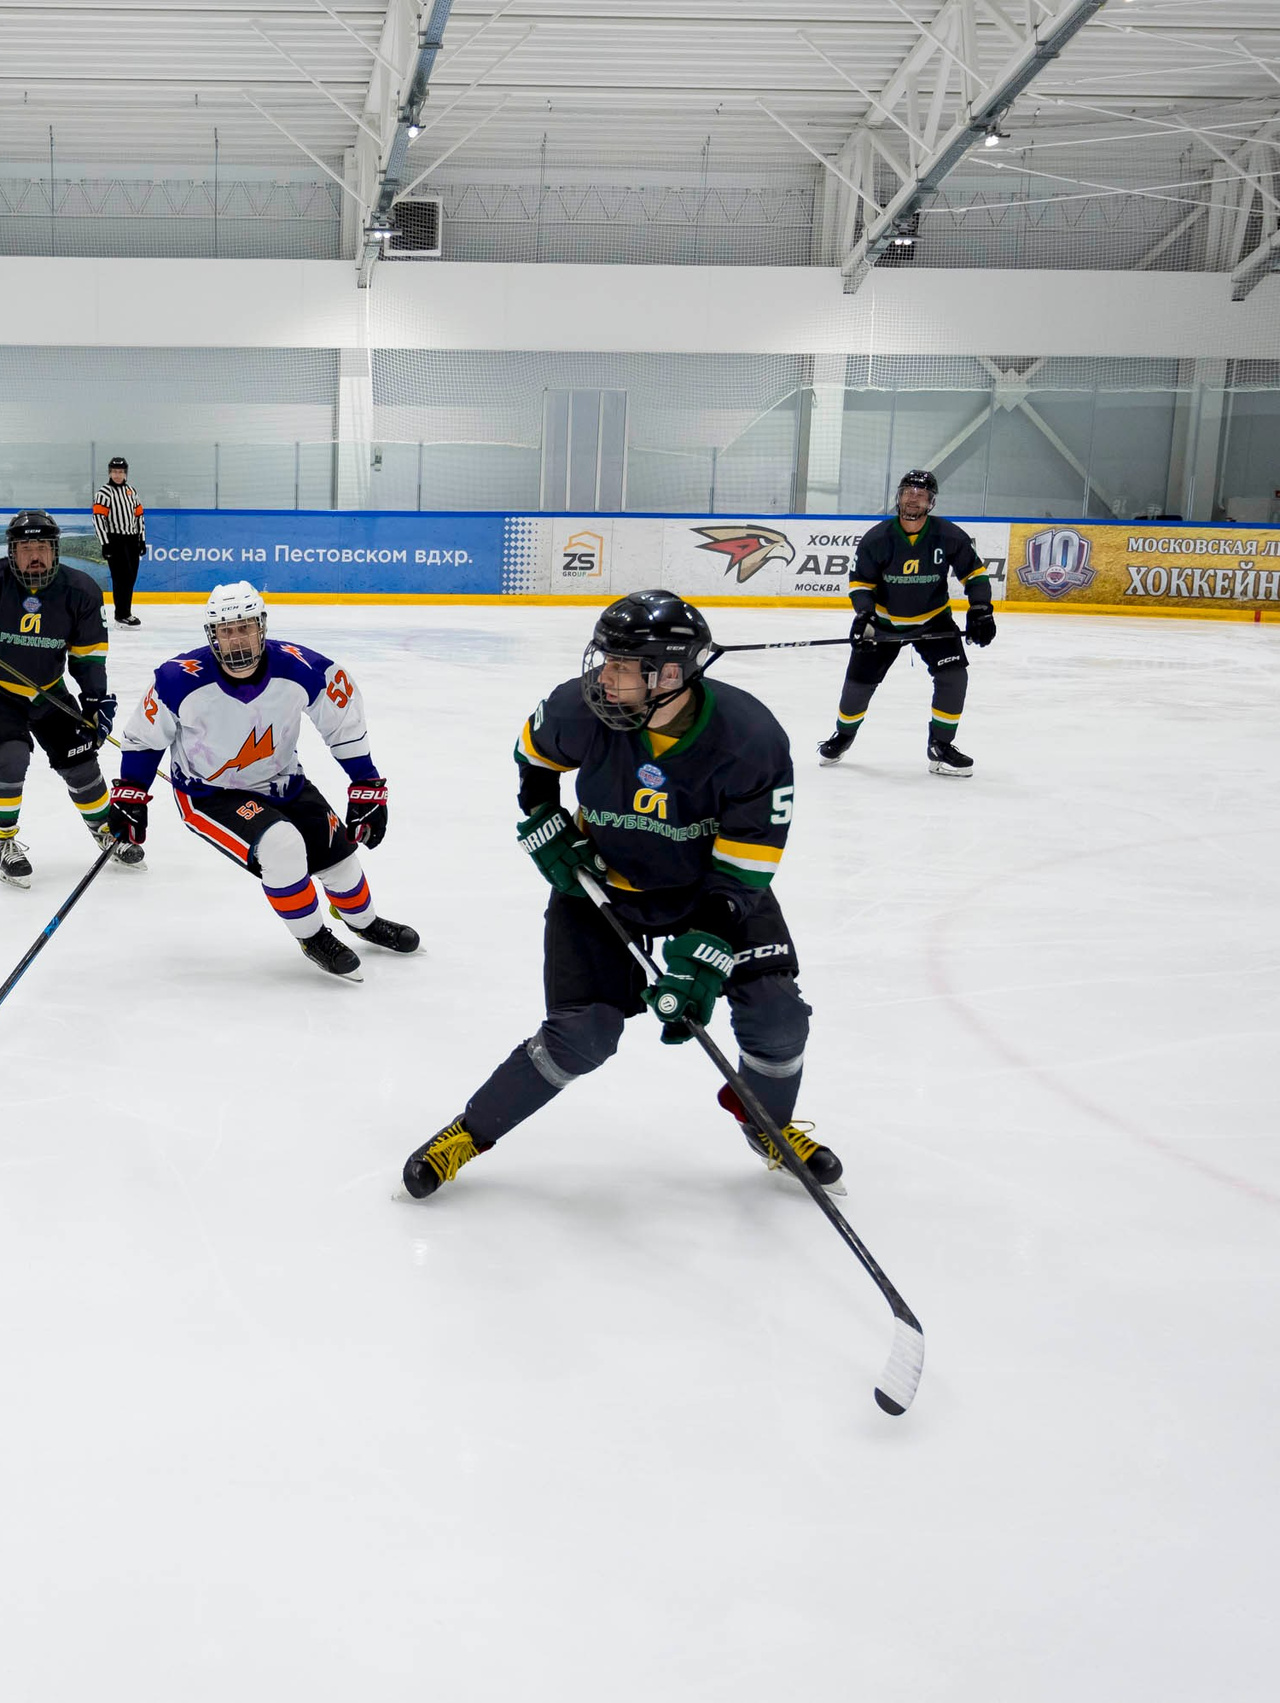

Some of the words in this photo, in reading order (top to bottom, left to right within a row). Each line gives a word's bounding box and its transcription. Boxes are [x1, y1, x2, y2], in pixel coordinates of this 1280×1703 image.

[241, 548, 267, 562] на
[274, 544, 408, 564] Пестовском
[414, 550, 474, 567] вдхр.
[933, 548, 944, 565] C
[1035, 531, 1080, 572] 10
[1127, 537, 1258, 557] МОСКОВСКАЯ
[562, 553, 595, 571] ZS
[794, 583, 841, 592] МОСКВА
[1125, 561, 1280, 601] ХОККЕЙН
[938, 655, 961, 667] CCM
[326, 669, 353, 709] 52
[143, 686, 158, 725] 52
[236, 800, 264, 820] 52
[770, 786, 794, 825] 5
[732, 944, 789, 966] CCM
